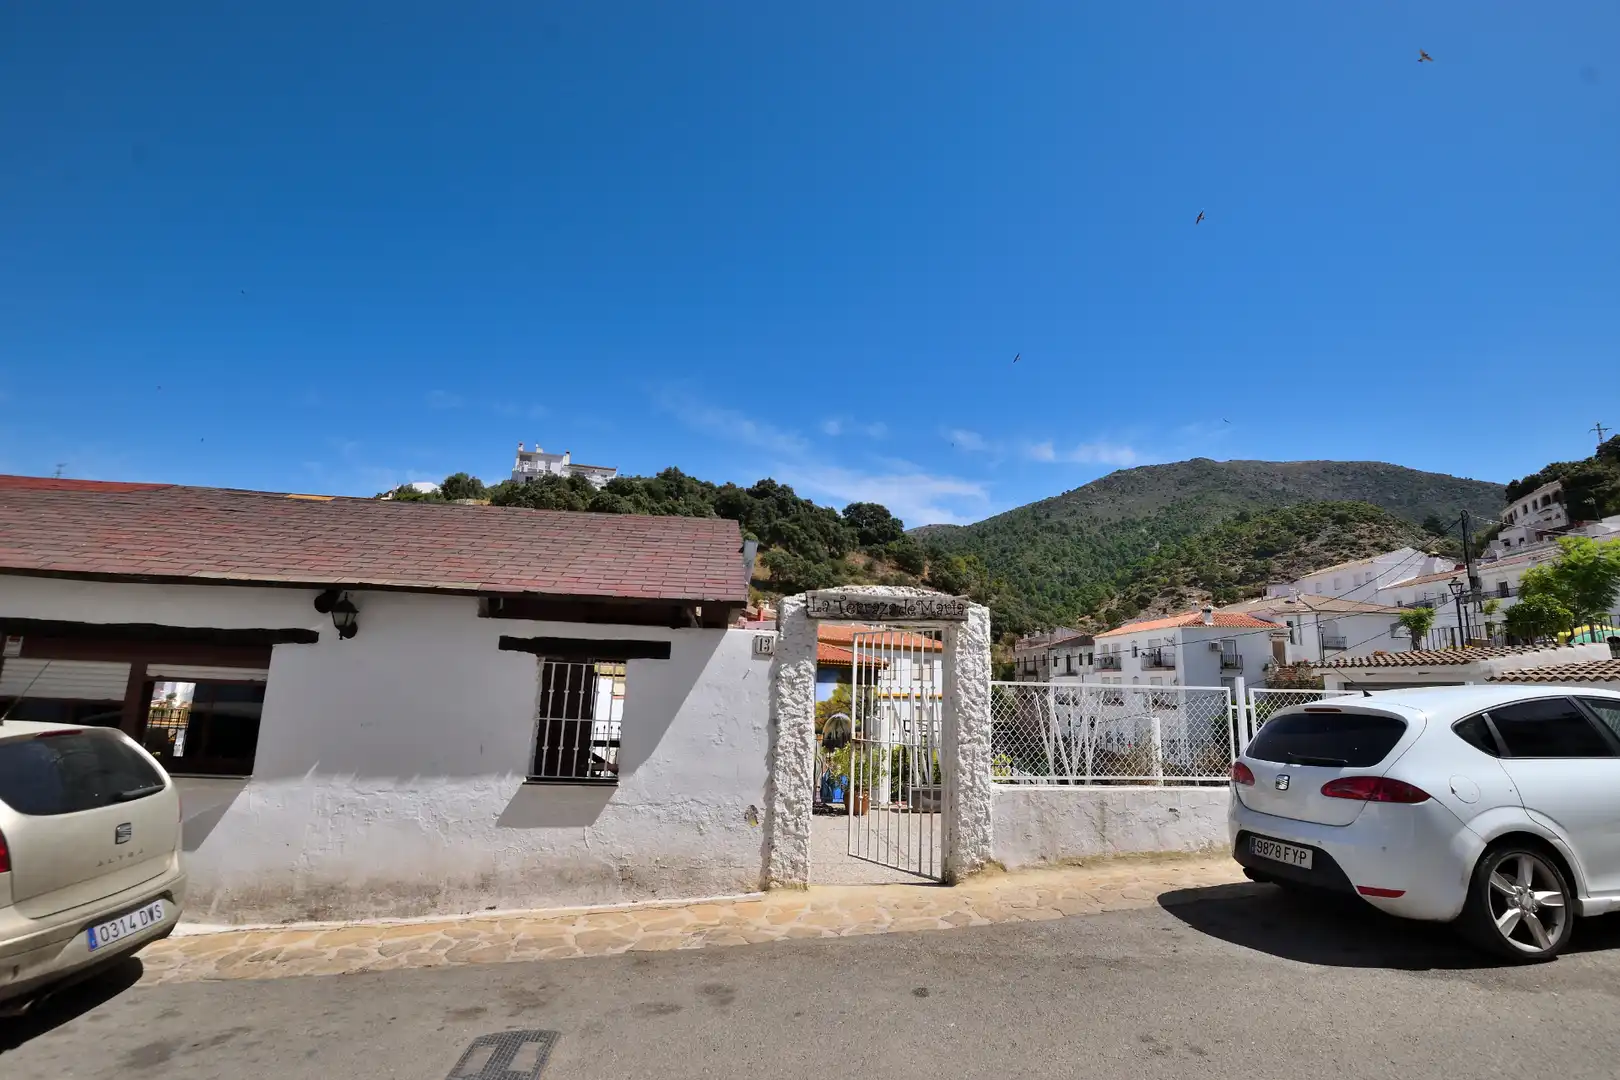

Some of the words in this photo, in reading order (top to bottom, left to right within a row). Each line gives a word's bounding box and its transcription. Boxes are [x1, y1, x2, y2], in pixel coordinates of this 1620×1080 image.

[811, 596, 830, 613] La
[834, 595, 899, 617] Terraza
[899, 599, 917, 616] de
[759, 638, 771, 651] 13
[1256, 840, 1281, 859] 9878
[1284, 846, 1307, 864] FYP
[100, 915, 136, 942] 0314
